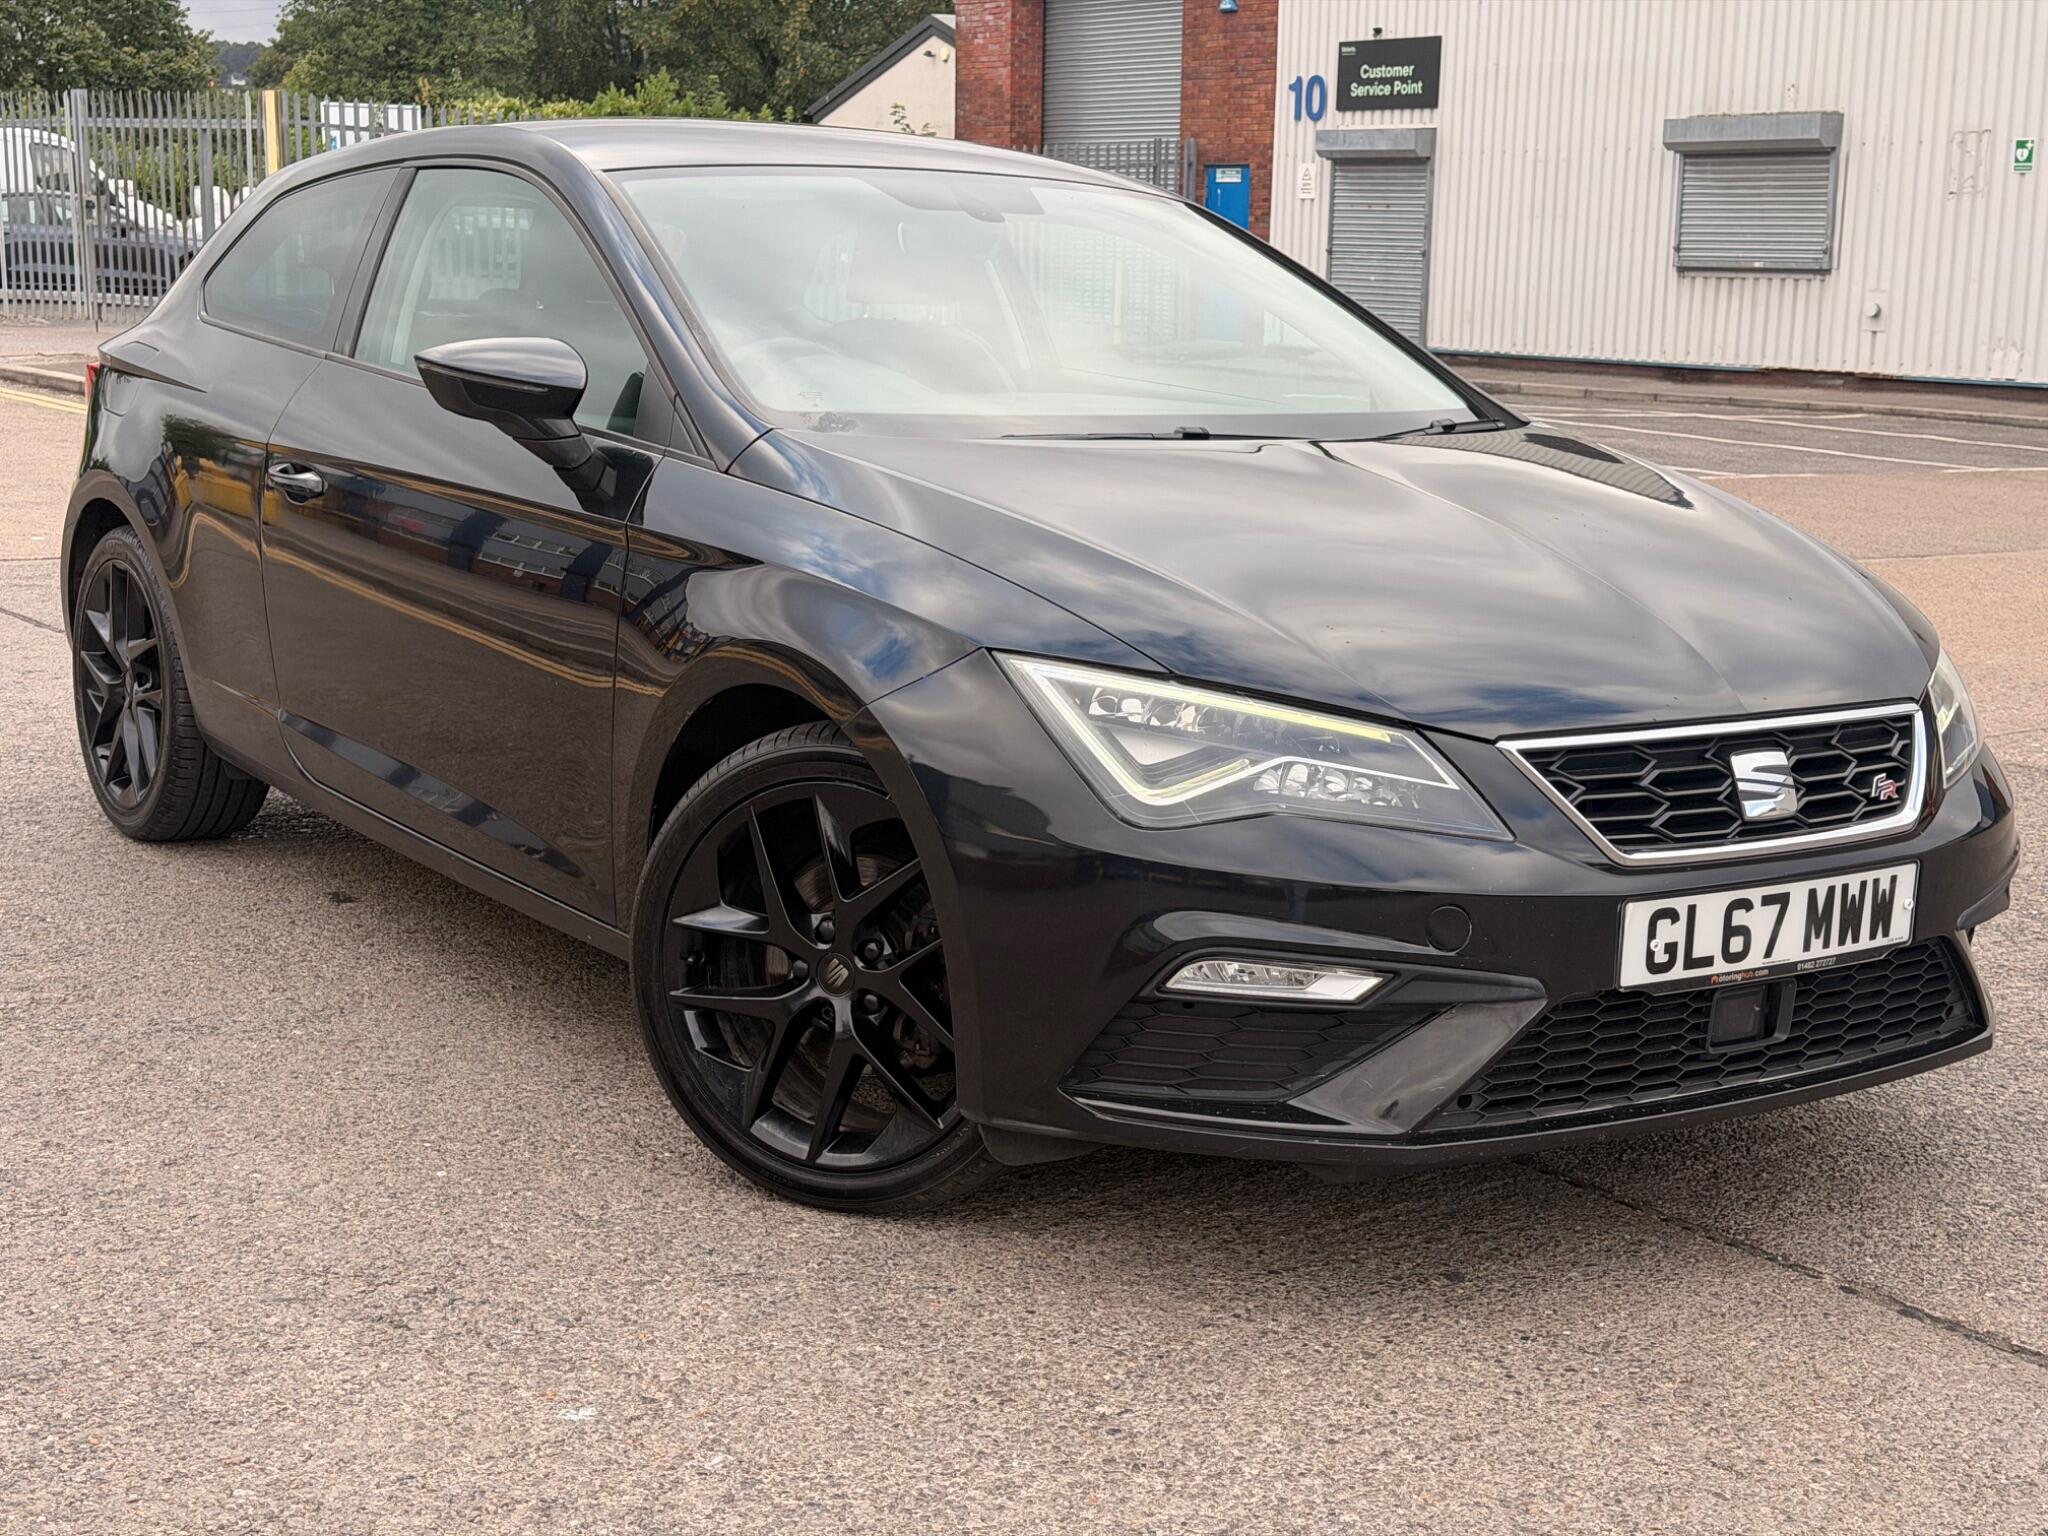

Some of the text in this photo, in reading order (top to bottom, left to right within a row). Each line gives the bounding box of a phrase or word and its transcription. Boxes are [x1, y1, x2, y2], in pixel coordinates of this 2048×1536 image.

[1360, 64, 1415, 79] Customer
[1289, 75, 1326, 122] 10
[1350, 80, 1423, 97] Service Point
[1870, 772, 1899, 800] FR
[1645, 874, 1898, 975] GL67 MWW
